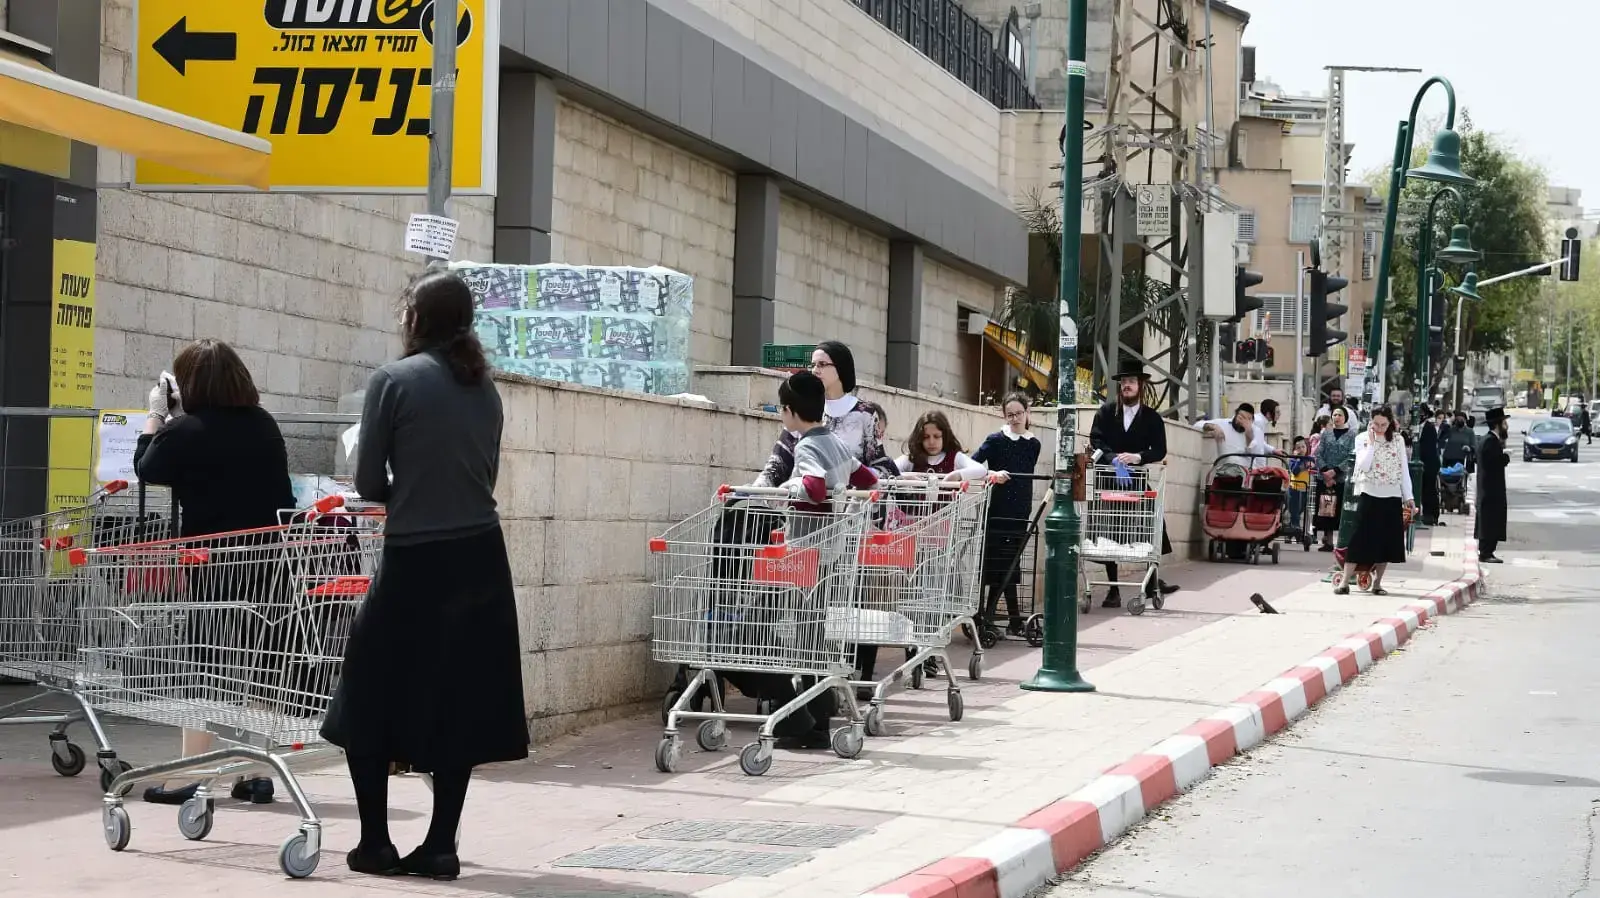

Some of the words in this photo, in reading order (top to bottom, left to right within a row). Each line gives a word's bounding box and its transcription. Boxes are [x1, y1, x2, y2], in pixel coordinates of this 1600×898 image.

[272, 32, 316, 52] בזול.
[322, 34, 368, 53] תצאו
[374, 35, 418, 53] תמיד
[60, 273, 91, 298] שעות
[57, 303, 93, 329] פתיחה
[609, 327, 635, 342] lovely
